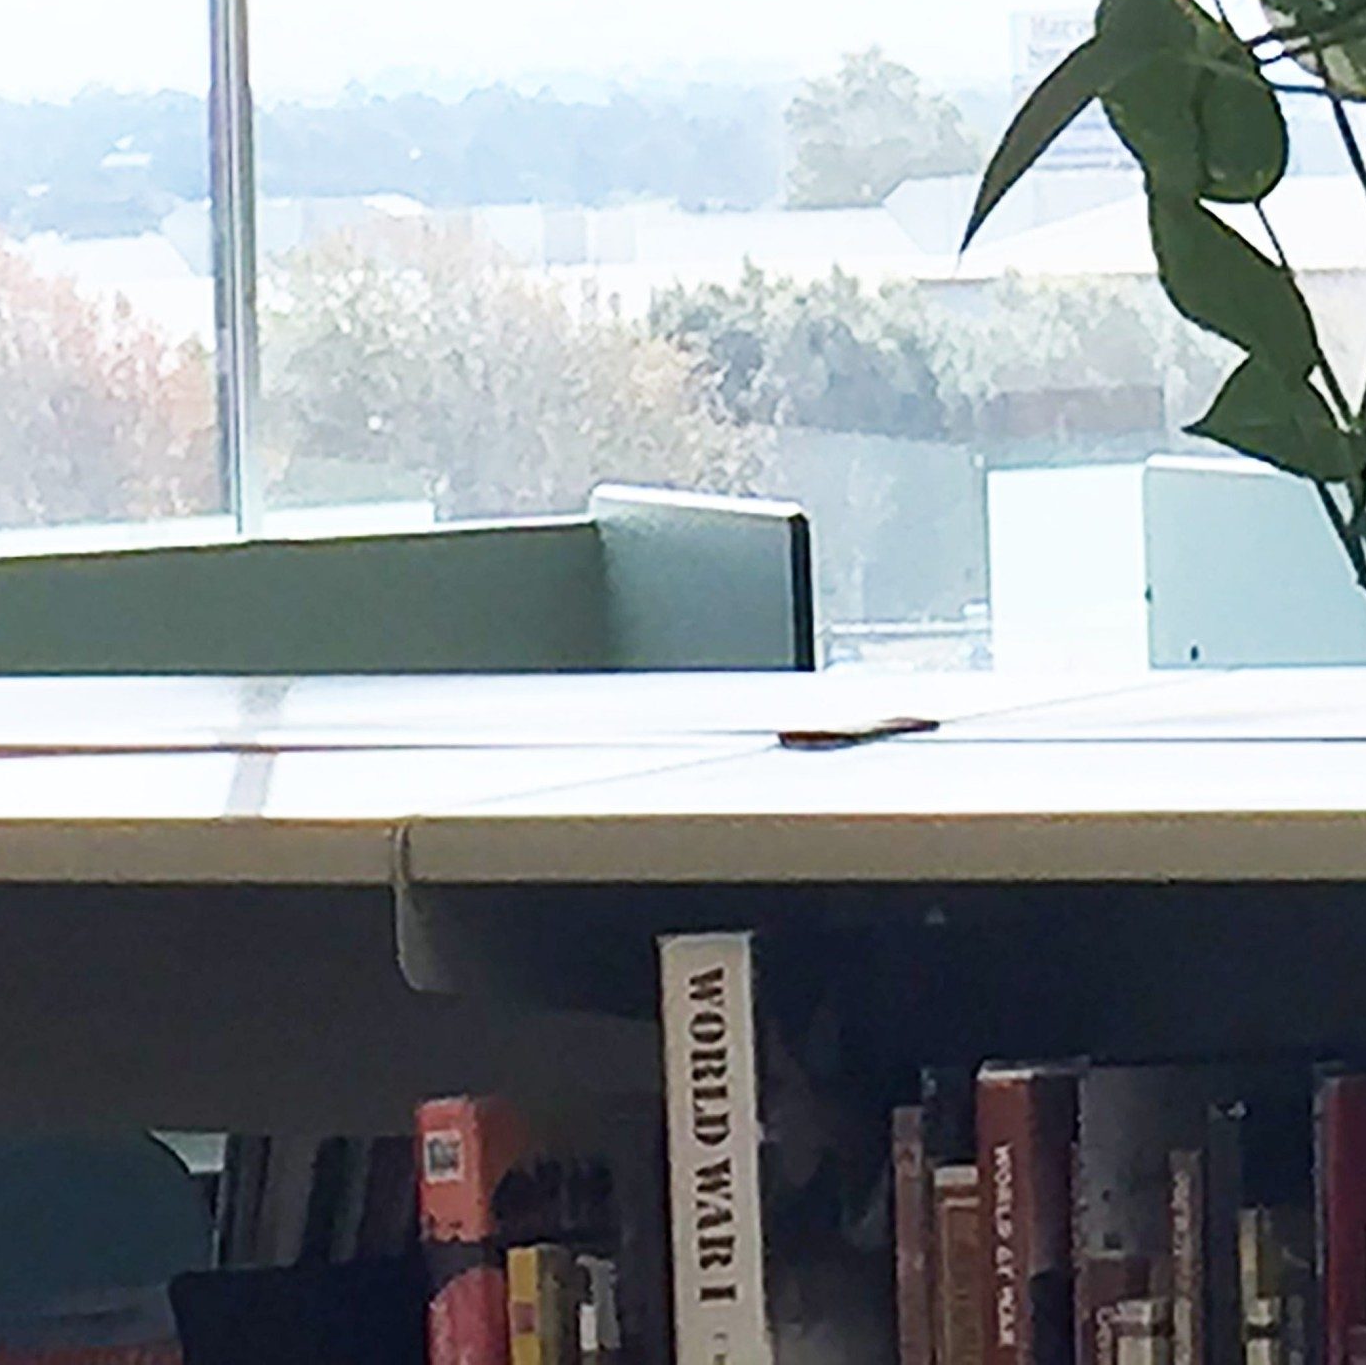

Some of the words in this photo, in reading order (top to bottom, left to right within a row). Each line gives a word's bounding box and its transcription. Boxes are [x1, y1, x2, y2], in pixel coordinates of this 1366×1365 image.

[688, 966, 731, 1147] WORLD
[695, 1156, 736, 1271] WAR
[993, 1141, 1016, 1238] WORLD
[699, 1282, 737, 1303] I
